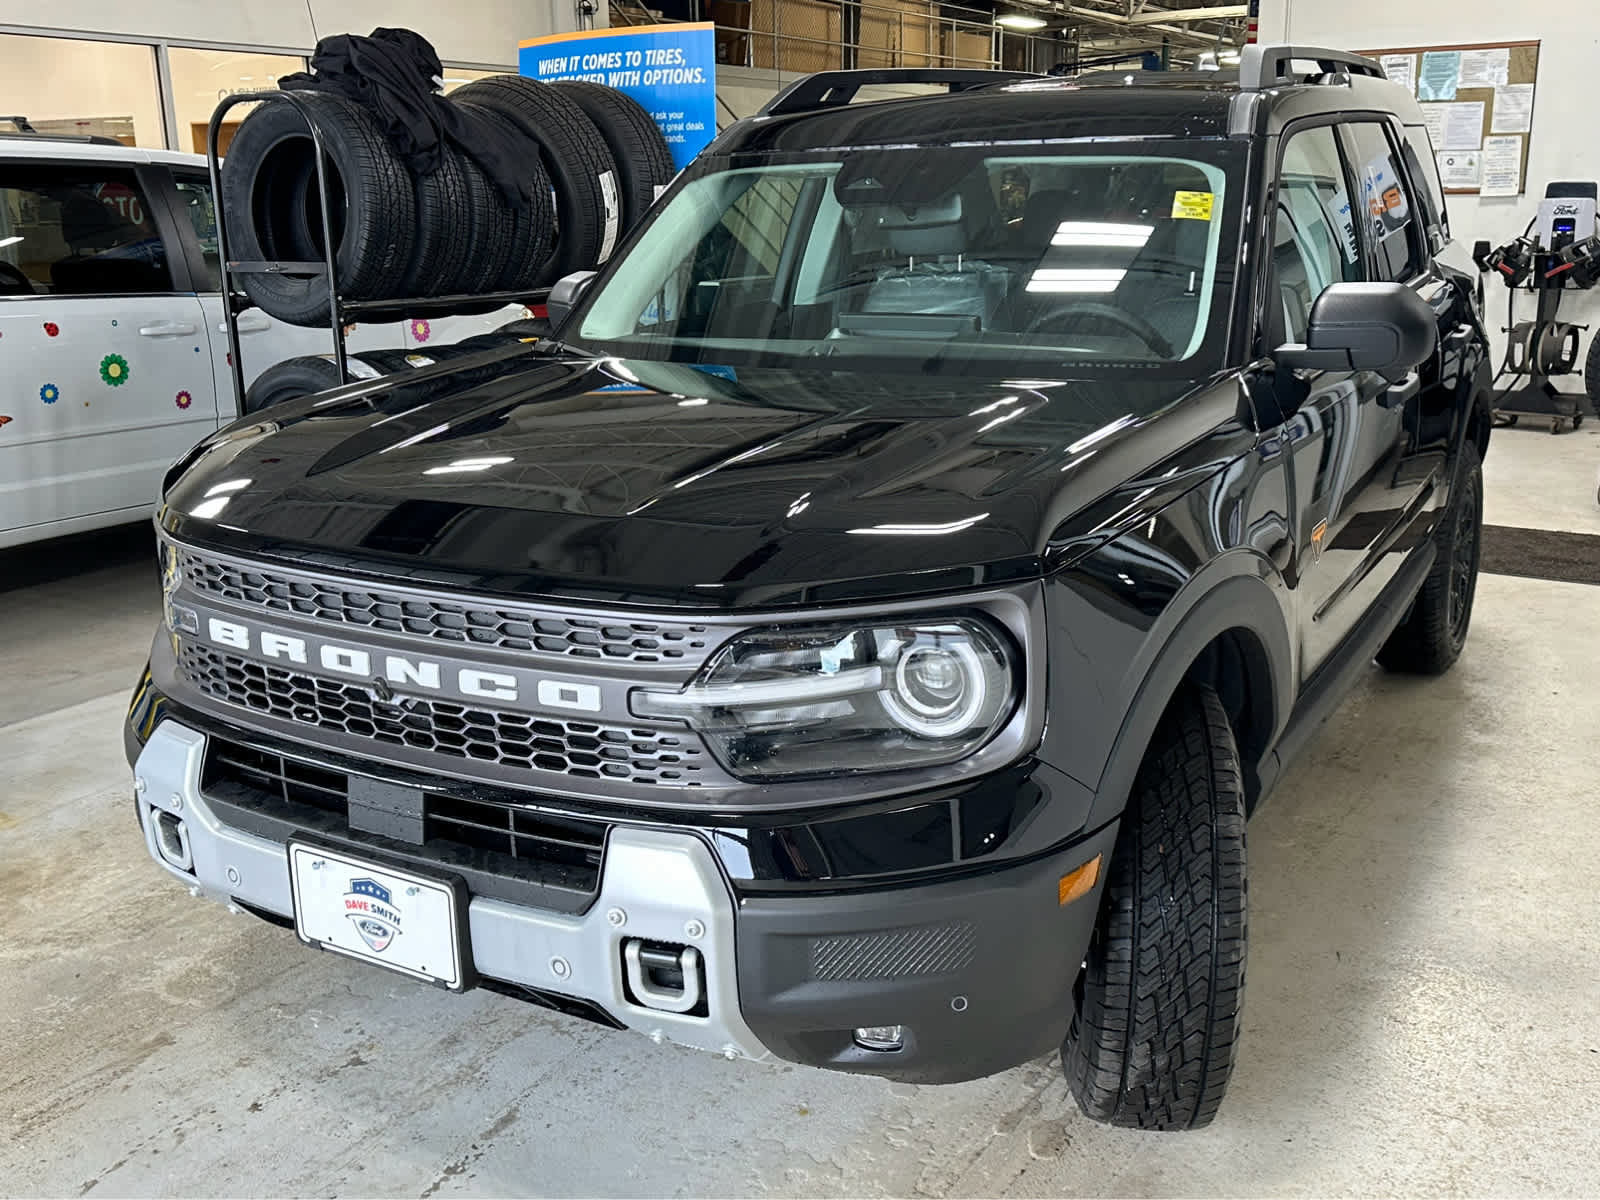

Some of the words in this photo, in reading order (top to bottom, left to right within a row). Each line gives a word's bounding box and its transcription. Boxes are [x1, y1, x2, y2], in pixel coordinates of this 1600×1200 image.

[538, 57, 567, 76] WHEN
[569, 56, 580, 71] IT
[582, 53, 622, 70] COMES
[625, 51, 642, 67] TO
[645, 48, 687, 67] TIRES,
[608, 70, 641, 88] WITH
[643, 68, 707, 86] OPTIONS.
[668, 112, 684, 121] your
[666, 121, 684, 133] great
[685, 121, 705, 131] deals
[1553, 204, 1579, 215] Ford
[208, 616, 602, 712] BRONCO
[344, 899, 369, 911] DAVE
[370, 903, 401, 926] SMITH
